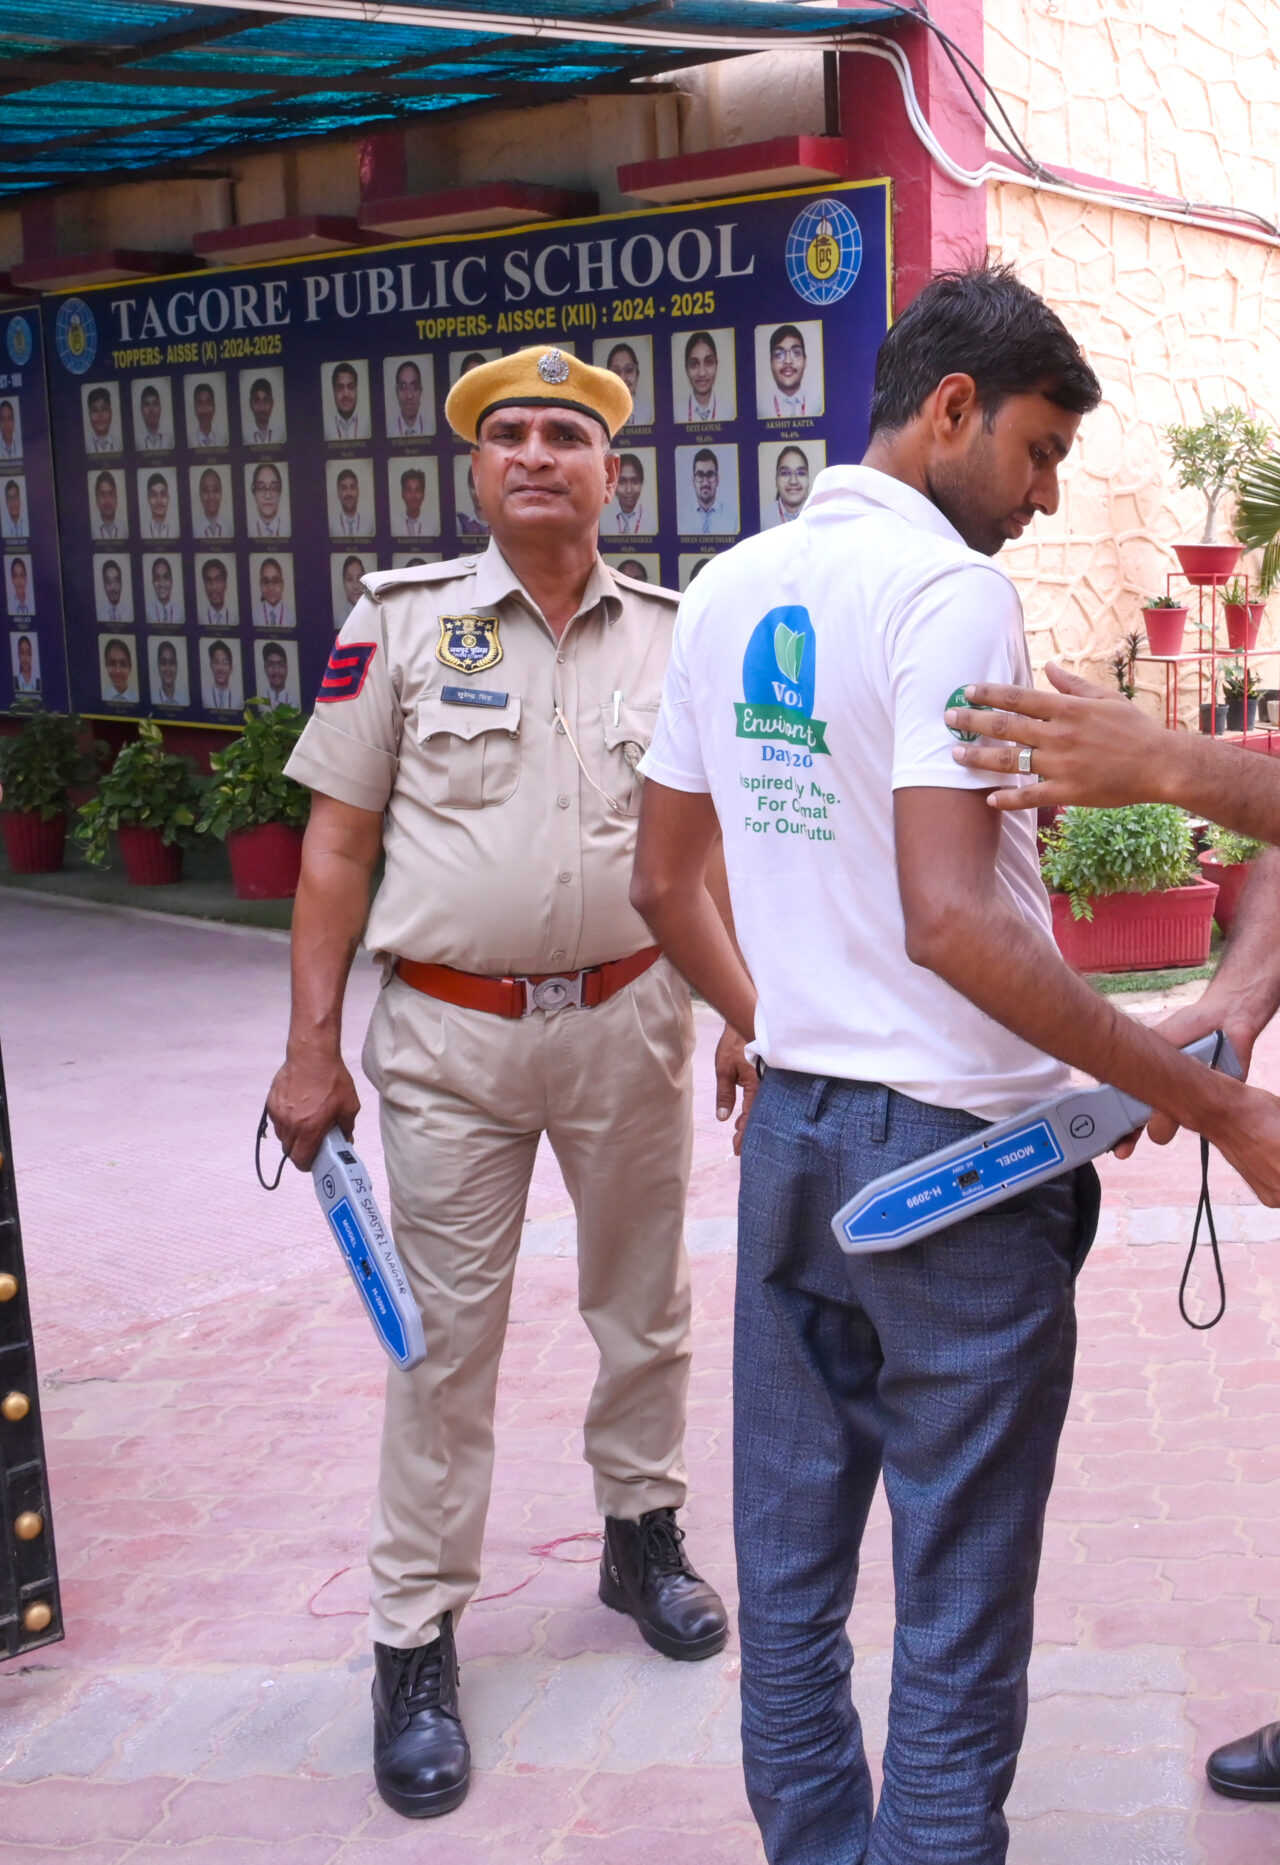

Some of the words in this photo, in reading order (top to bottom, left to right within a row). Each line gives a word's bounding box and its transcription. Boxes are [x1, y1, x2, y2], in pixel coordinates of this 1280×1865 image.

[111, 280, 291, 342] TAGORE
[303, 256, 488, 323] PUBLIC
[503, 223, 755, 302] SCHOOL
[415, 314, 492, 340] TOPPERS-
[496, 306, 556, 333] AISSCE
[561, 302, 597, 332] (XII)
[612, 296, 655, 322] 2024
[670, 290, 715, 317] 2025
[166, 342, 199, 364] AISSE
[201, 341, 217, 365] (X)
[758, 796, 787, 812] For
[745, 817, 770, 833] For
[995, 1144, 1035, 1167] MODEL
[906, 1185, 942, 1209] H-2099
[342, 1219, 357, 1248] MODEL
[351, 1178, 367, 1194] PS
[361, 1198, 389, 1247] SHASTRI
[384, 1252, 407, 1295] NAGAR
